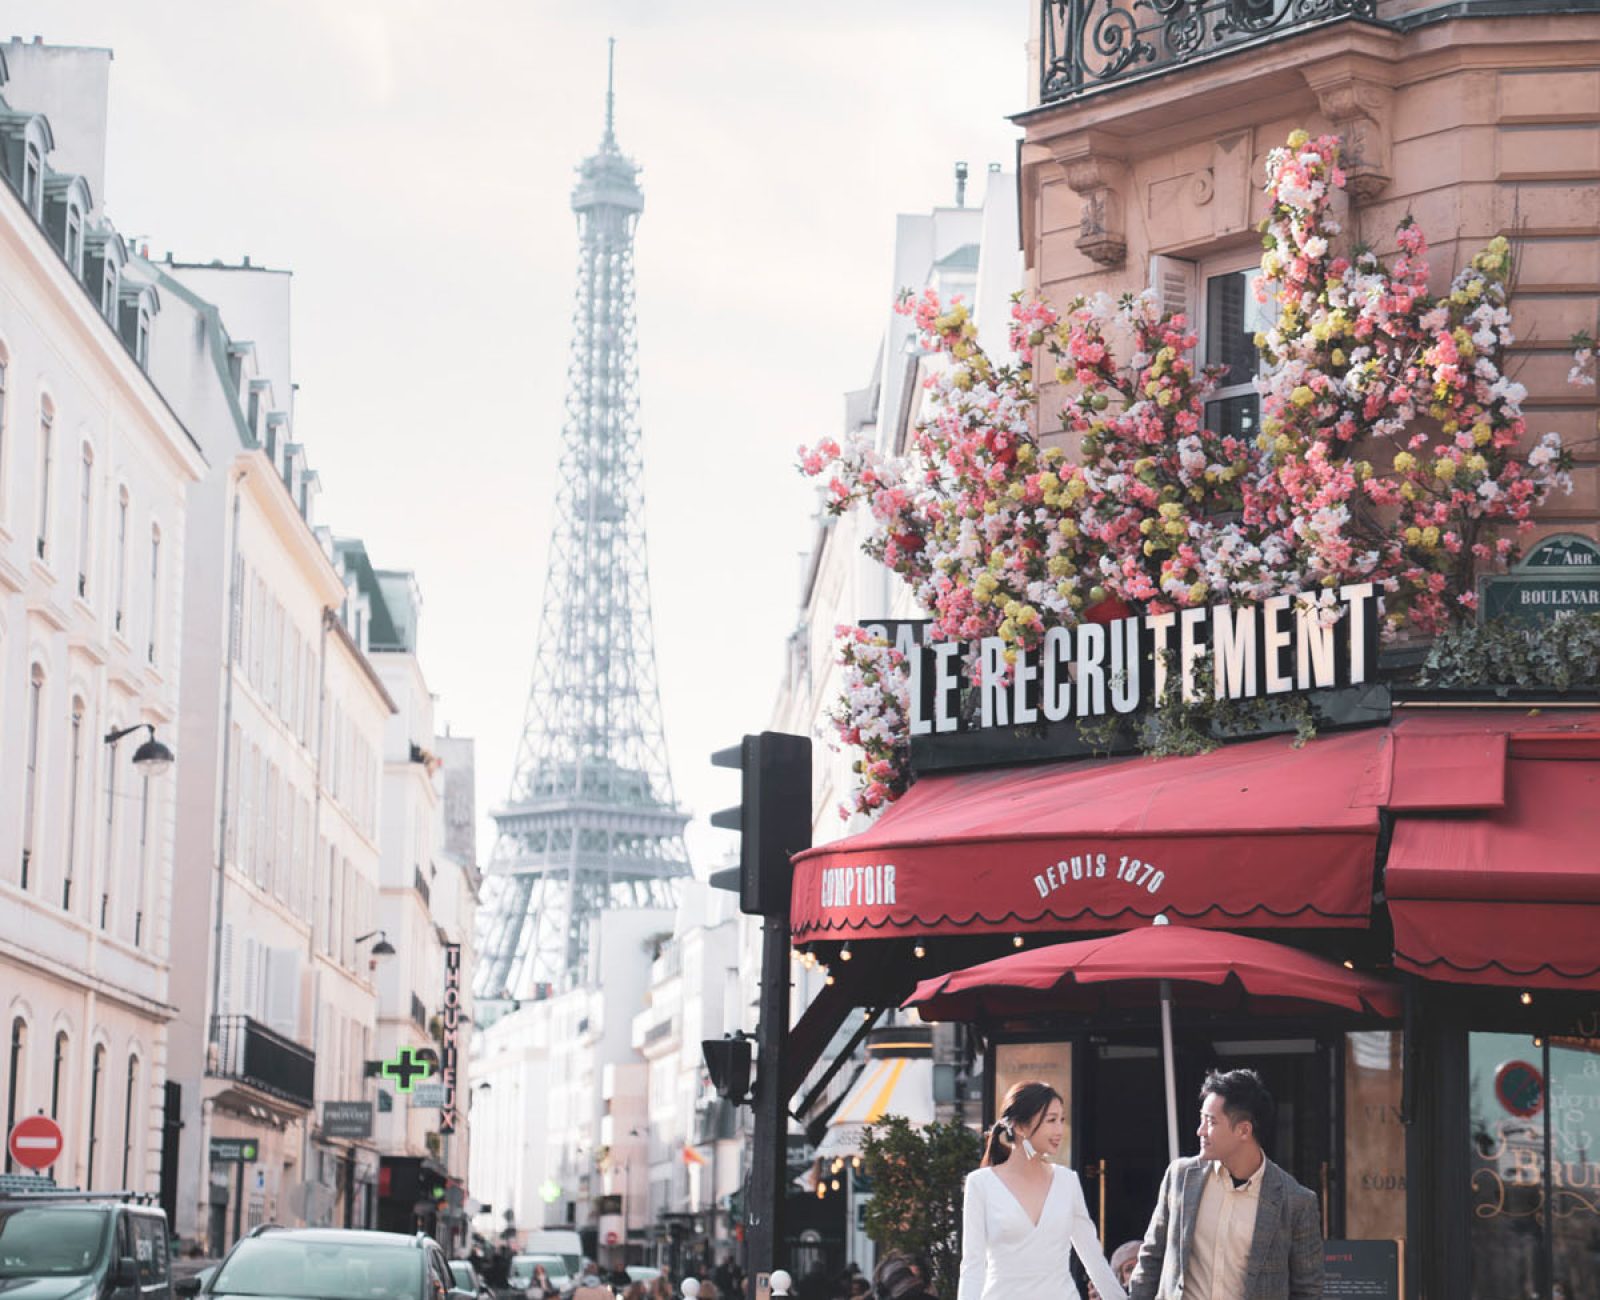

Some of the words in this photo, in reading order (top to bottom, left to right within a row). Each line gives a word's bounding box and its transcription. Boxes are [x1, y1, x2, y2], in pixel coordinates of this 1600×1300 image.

[1520, 590, 1600, 604] BOULEVAR
[909, 642, 960, 735] LE
[981, 583, 1373, 728] RECRUTEMENT
[821, 864, 897, 908] COMPTOIR
[1033, 853, 1107, 898] DEPUIS
[1116, 856, 1165, 893] 1870
[442, 947, 461, 1129] THOUMIEUX
